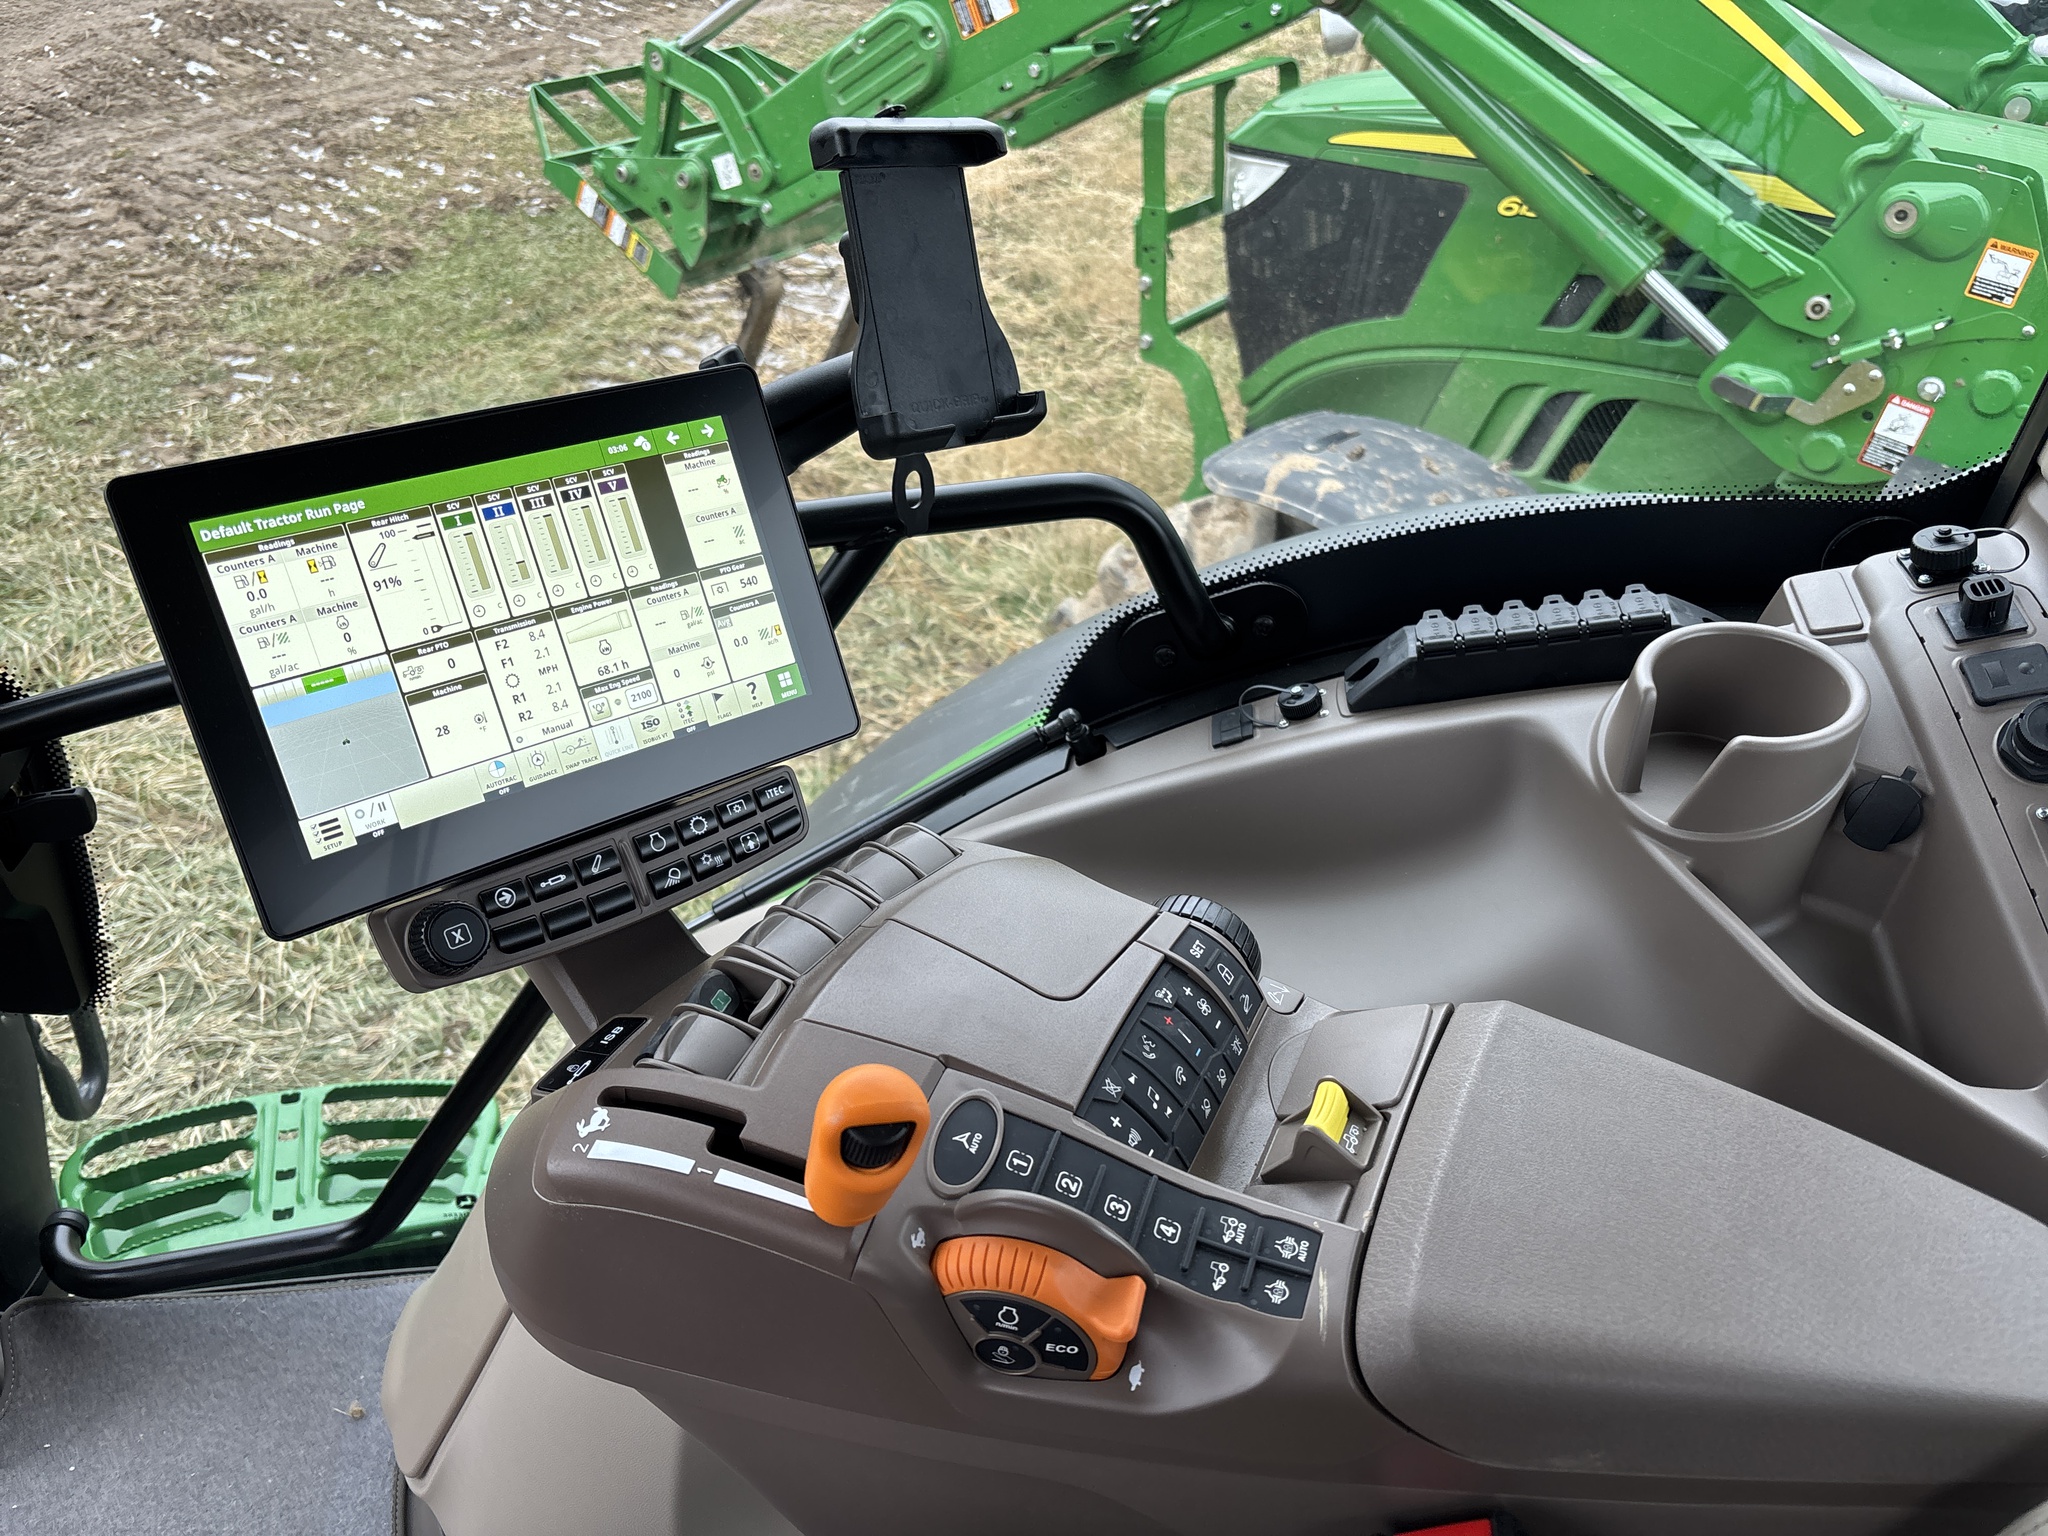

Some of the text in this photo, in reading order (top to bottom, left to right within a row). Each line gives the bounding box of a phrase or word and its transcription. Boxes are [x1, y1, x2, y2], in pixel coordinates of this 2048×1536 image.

[2000, 244, 2034, 259] WARNING
[607, 444, 628, 455] 03:06
[683, 448, 710, 459] Readings
[684, 457, 716, 471] Machine
[602, 468, 615, 477] SCV
[565, 476, 578, 485] SCV
[607, 481, 617, 491] V
[527, 484, 540, 493] SCV
[568, 488, 583, 501] IV
[487, 493, 501, 502] SCV
[530, 496, 547, 509] III
[446, 502, 460, 511] SCV
[492, 506, 506, 518] II
[200, 499, 366, 542] Default Tractor Run Page
[371, 513, 410, 528] Rear Hitch
[456, 516, 463, 526] I
[695, 507, 737, 523] Counters A
[379, 529, 396, 540] 100
[258, 538, 295, 552] Readings
[295, 540, 338, 557] Machine
[216, 554, 276, 575] Counters A
[719, 562, 746, 574] PTO Gear
[373, 576, 402, 592] 91%
[651, 580, 679, 592] Readings
[740, 575, 758, 588] 540
[246, 587, 268, 602] 0.0
[646, 588, 690, 606] Counters A
[249, 603, 276, 618] gal/h
[316, 600, 359, 617] Machine
[571, 597, 613, 615] Engine Power
[729, 601, 753, 613] Counters
[238, 615, 297, 635] Counters A
[423, 627, 429, 635] 0
[493, 617, 536, 635] Transmission
[343, 632, 352, 643] 0
[529, 629, 546, 641] 8.4
[767, 637, 779, 646] ac/h
[417, 641, 449, 655] Rear PTO
[495, 638, 510, 650] F2
[667, 640, 700, 655] Machine
[733, 636, 749, 648] 0.0
[348, 646, 357, 655] %
[534, 647, 550, 660] 2.1
[447, 658, 456, 669] 0
[501, 656, 515, 669] F1
[597, 660, 630, 676] 68.1 h
[268, 662, 300, 679] gal/ac
[538, 664, 559, 677] MPH
[673, 668, 680, 678] 0
[432, 683, 462, 698] Machine
[546, 682, 562, 695] 2.1
[594, 675, 641, 694] Max Eng Speed
[512, 692, 527, 705] R1
[630, 689, 652, 703] 2100
[781, 688, 797, 699] MENU
[552, 699, 569, 712] 8.4
[751, 701, 763, 709] HELP
[518, 709, 534, 722] R2
[717, 711, 732, 720] FLAGS
[541, 719, 574, 736] Manual
[641, 717, 661, 730] ISO
[435, 725, 450, 737] 28
[642, 734, 660, 745] ISOBUS
[605, 743, 634, 757] QUICK LINE
[565, 755, 598, 771] SWAP TRACK
[528, 768, 558, 782] GUIDANCE
[486, 774, 517, 790] AUTOTRAC
[499, 787, 510, 795] OFF
[765, 785, 785, 799] iTEC
[365, 818, 386, 830] WORK
[372, 829, 385, 838] OFF
[323, 840, 343, 852] SETUP
[1190, 940, 1206, 959] SET
[572, 1143, 589, 1154] 2
[969, 1133, 983, 1155] AUTO
[1012, 1157, 1028, 1168] 1
[697, 1167, 713, 1176] 1
[1061, 1178, 1078, 1192] 2
[1109, 1201, 1126, 1215] 3
[1159, 1224, 1176, 1237] 4
[1234, 1222, 1247, 1245] AUTO
[1297, 1240, 1309, 1262] AUTO
[1045, 1343, 1079, 1354] ECO
